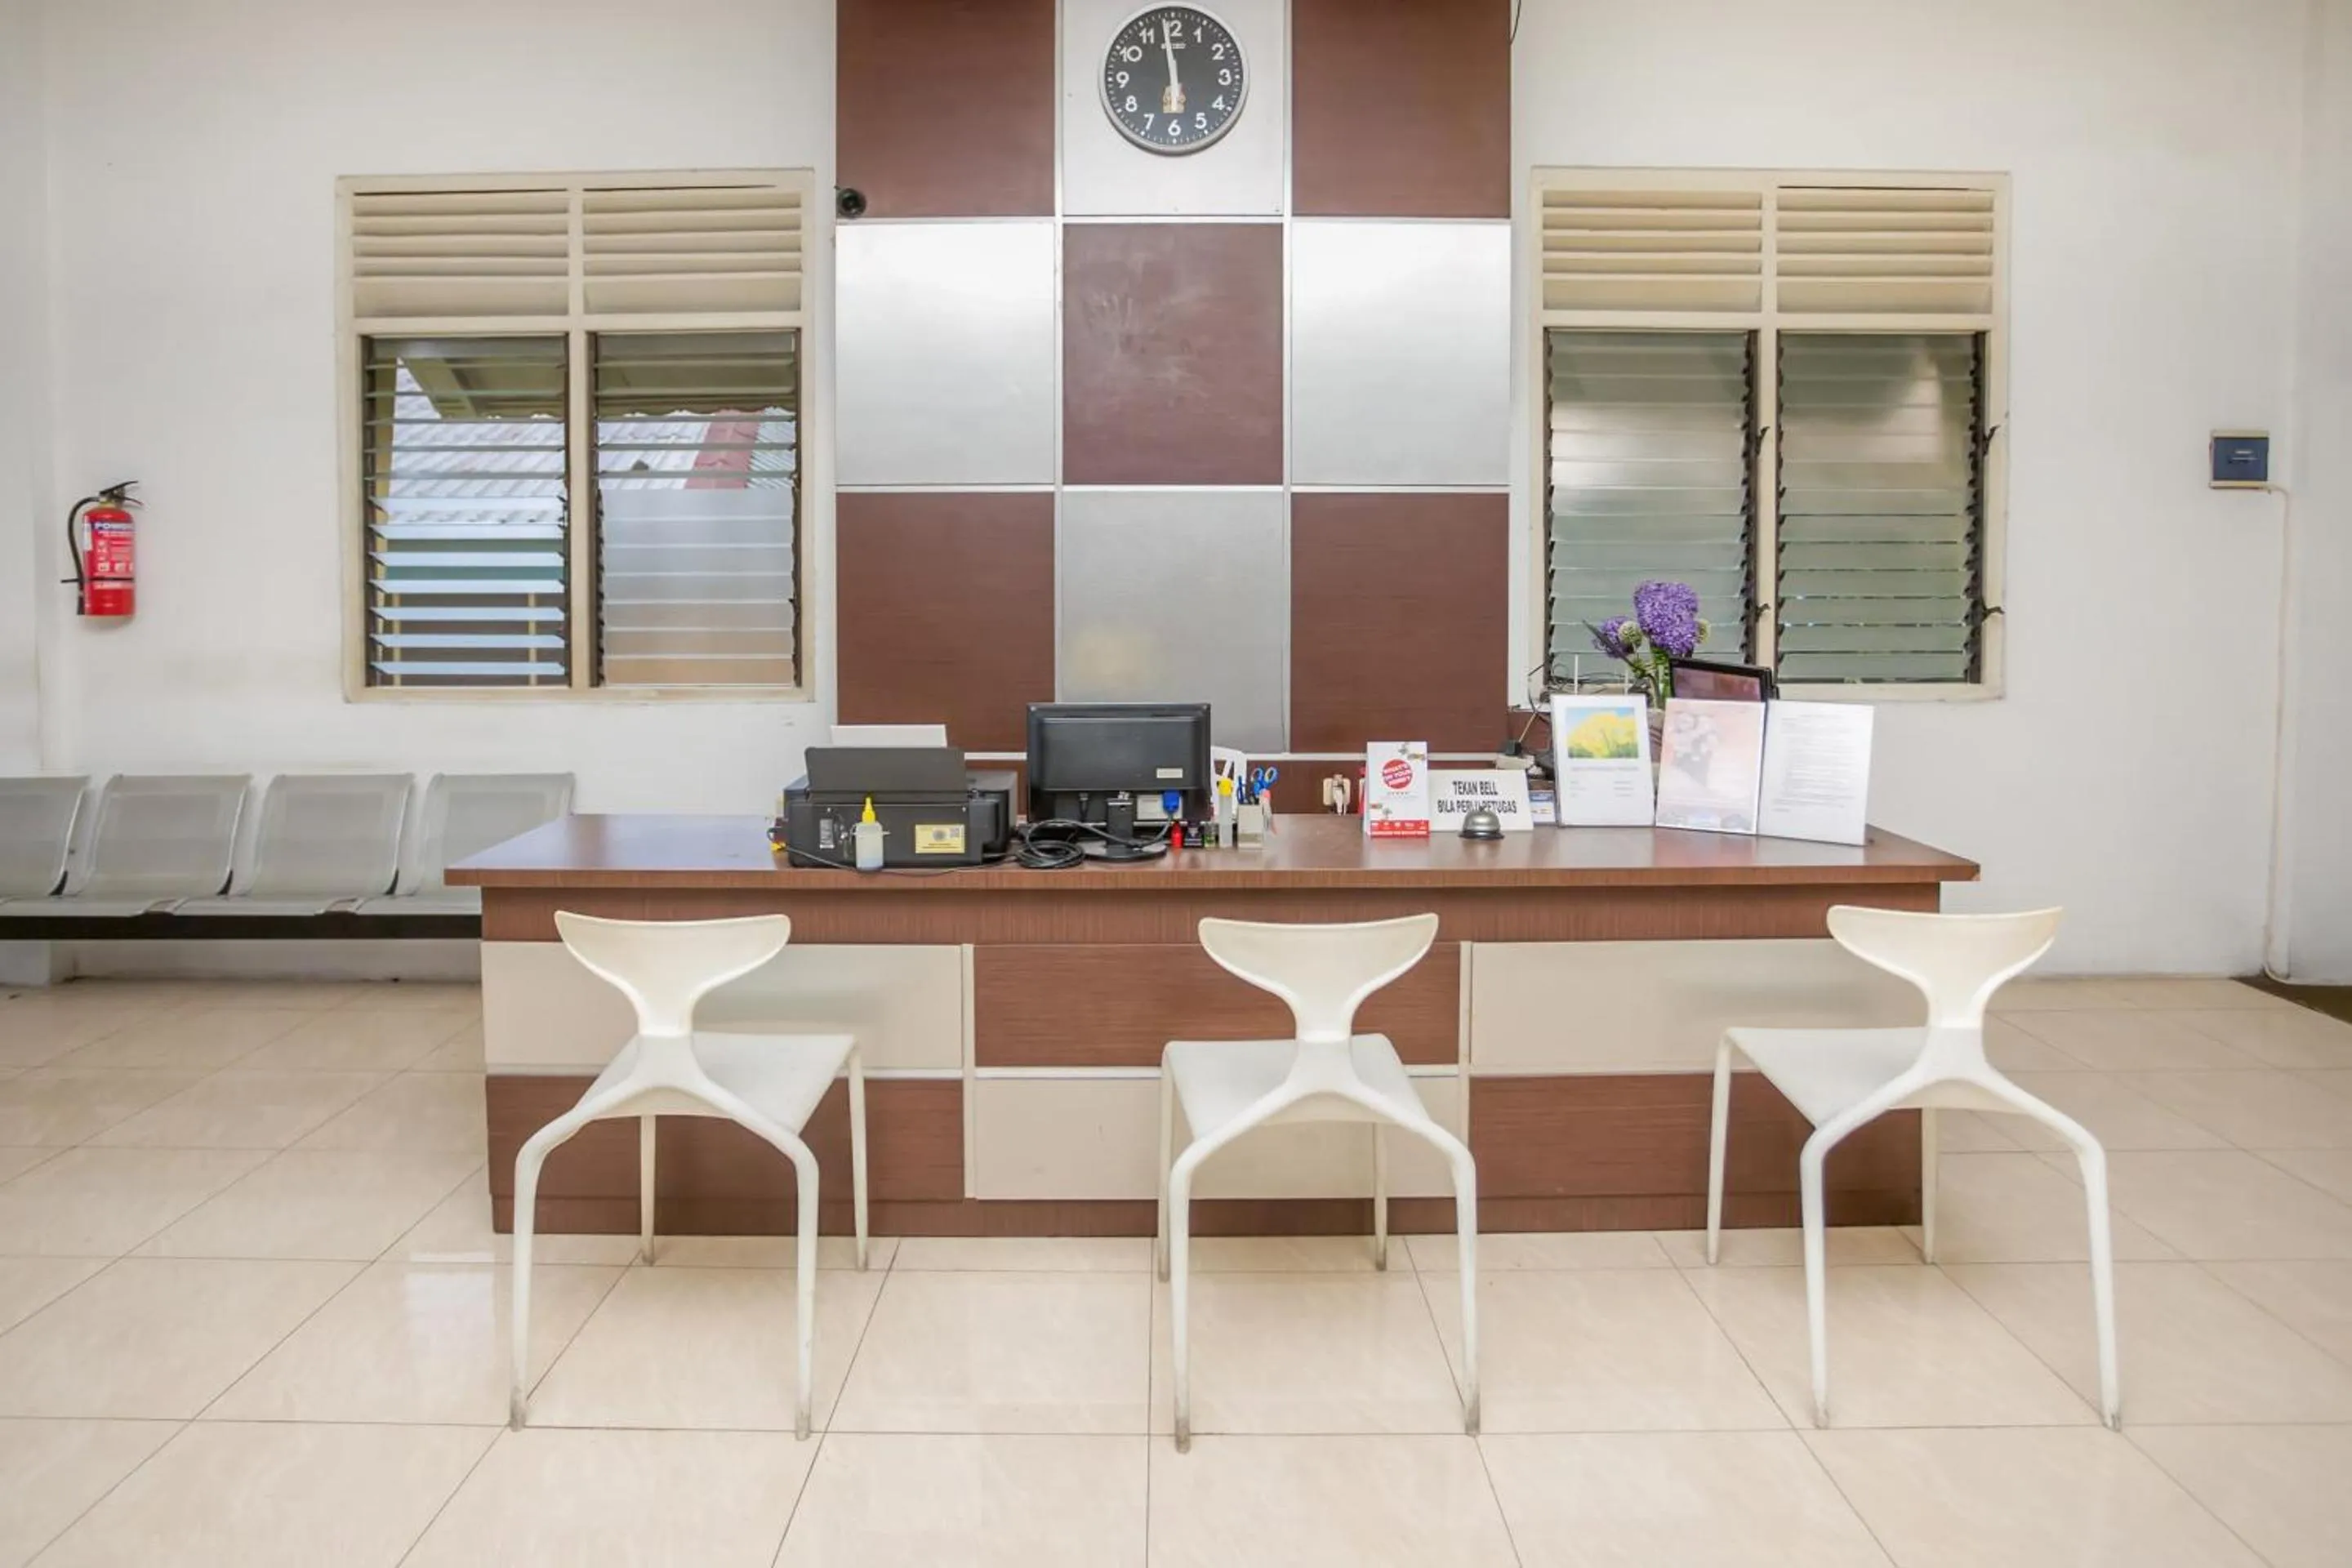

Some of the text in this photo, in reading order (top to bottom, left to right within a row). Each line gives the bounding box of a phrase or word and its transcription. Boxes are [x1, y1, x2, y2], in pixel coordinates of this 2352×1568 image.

[1139, 28, 1155, 44] 11
[1193, 27, 1202, 43] 1
[1120, 46, 1143, 62] 10
[1211, 43, 1225, 60] 2
[1116, 71, 1129, 88] 9
[1218, 69, 1232, 86] 3
[1125, 96, 1138, 112] 8
[1211, 95, 1226, 110] 4
[1143, 113, 1155, 130] 7
[1168, 119, 1181, 136] 6
[1194, 113, 1207, 129] 5
[1453, 781, 1498, 795] TEKAN BELL
[1437, 800, 1454, 813] BILA
